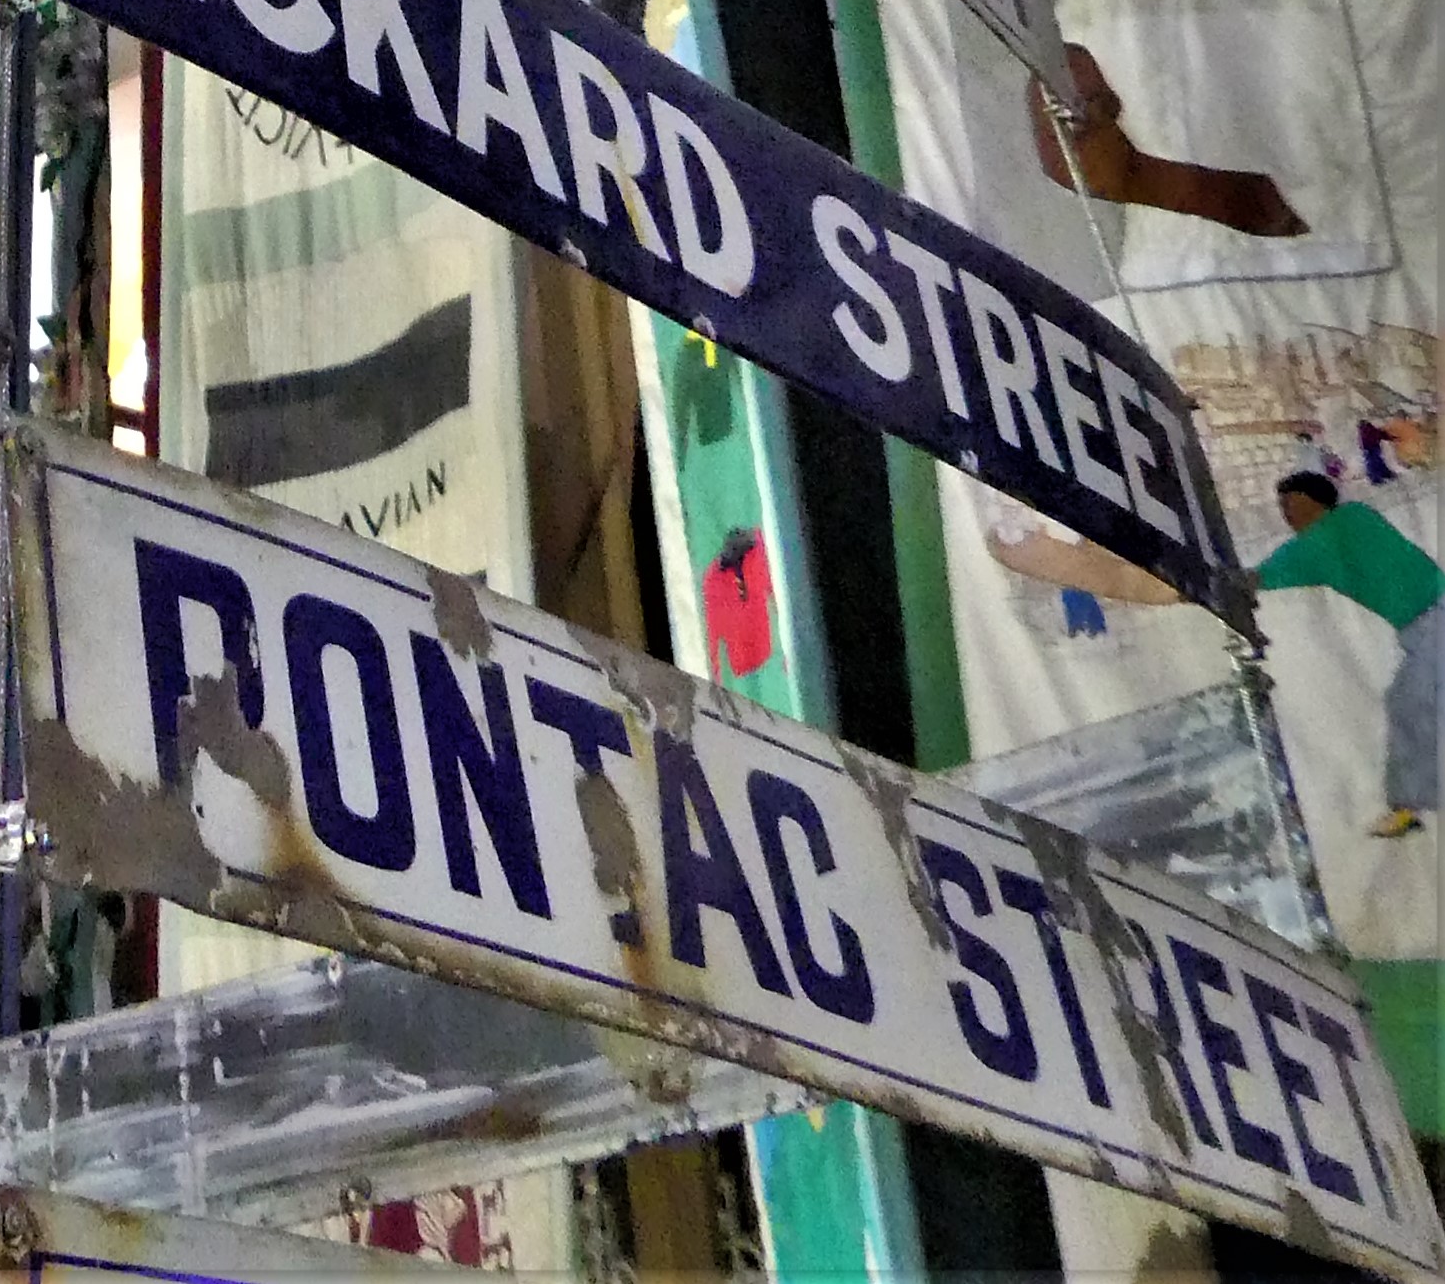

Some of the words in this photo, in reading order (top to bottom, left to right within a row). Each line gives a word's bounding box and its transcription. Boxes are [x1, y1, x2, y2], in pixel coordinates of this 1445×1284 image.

[811, 194, 1225, 568] STREET
[132, 537, 877, 1025] PONTAC
[916, 834, 1397, 1221] STREET
